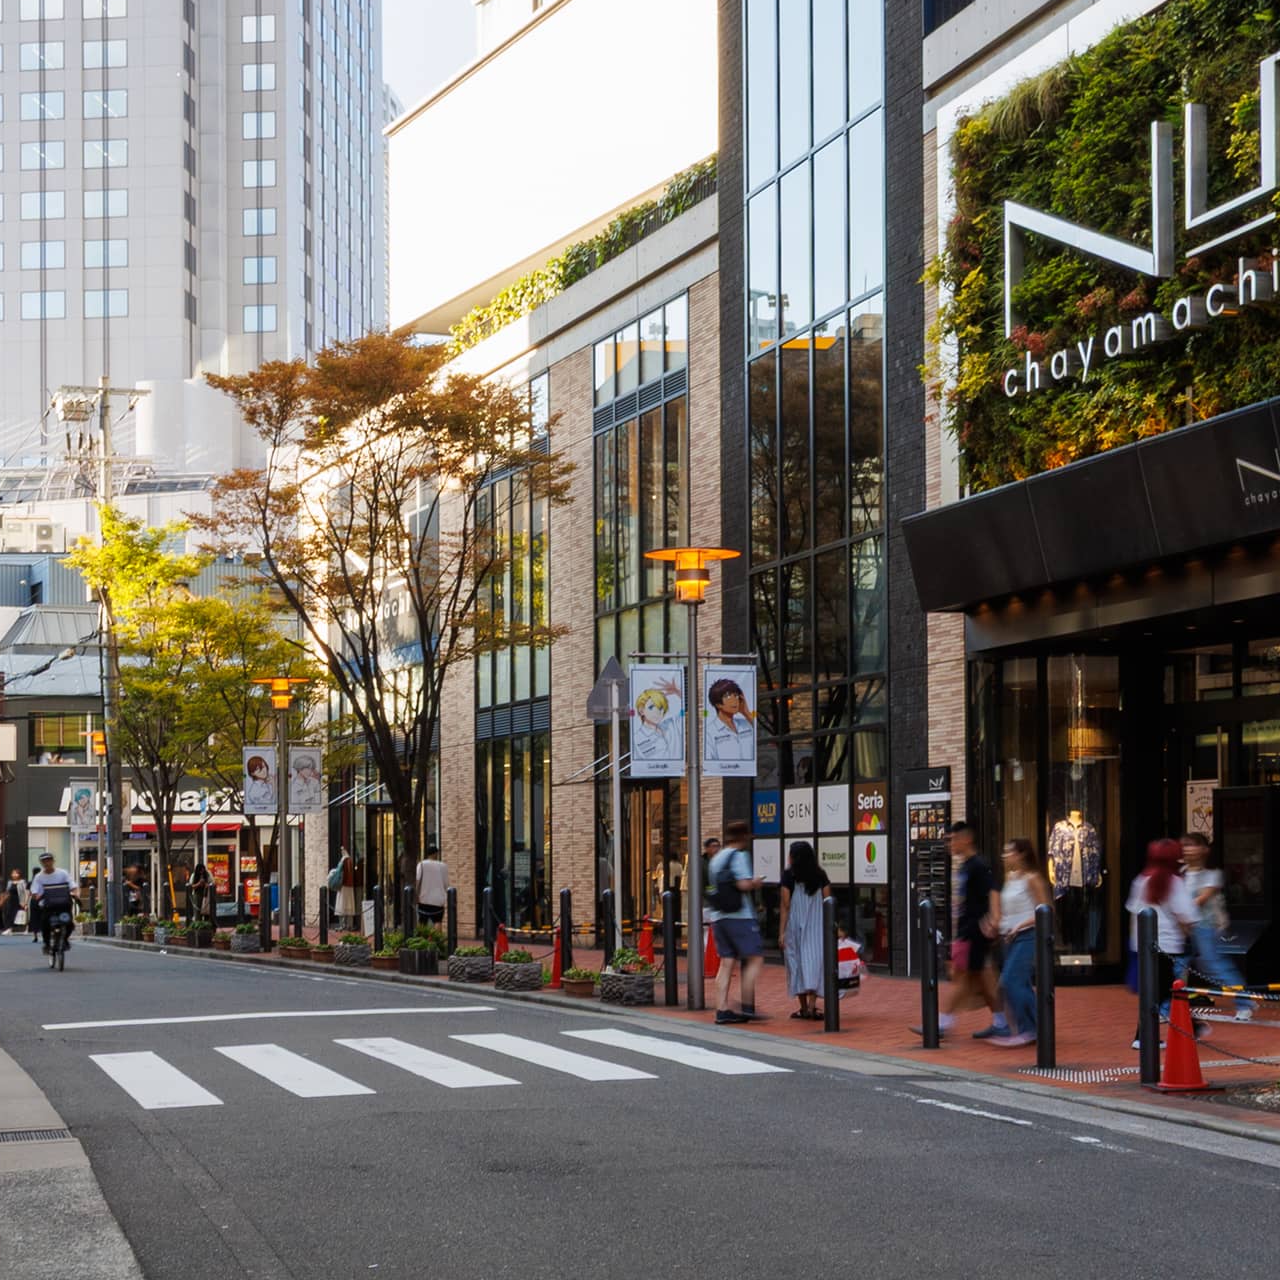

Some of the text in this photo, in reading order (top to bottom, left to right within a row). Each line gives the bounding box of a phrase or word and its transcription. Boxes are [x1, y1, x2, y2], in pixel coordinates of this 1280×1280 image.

[1004, 247, 1280, 398] chayamachi
[787, 802, 811, 818] GIEN
[857, 790, 884, 811] Seria
